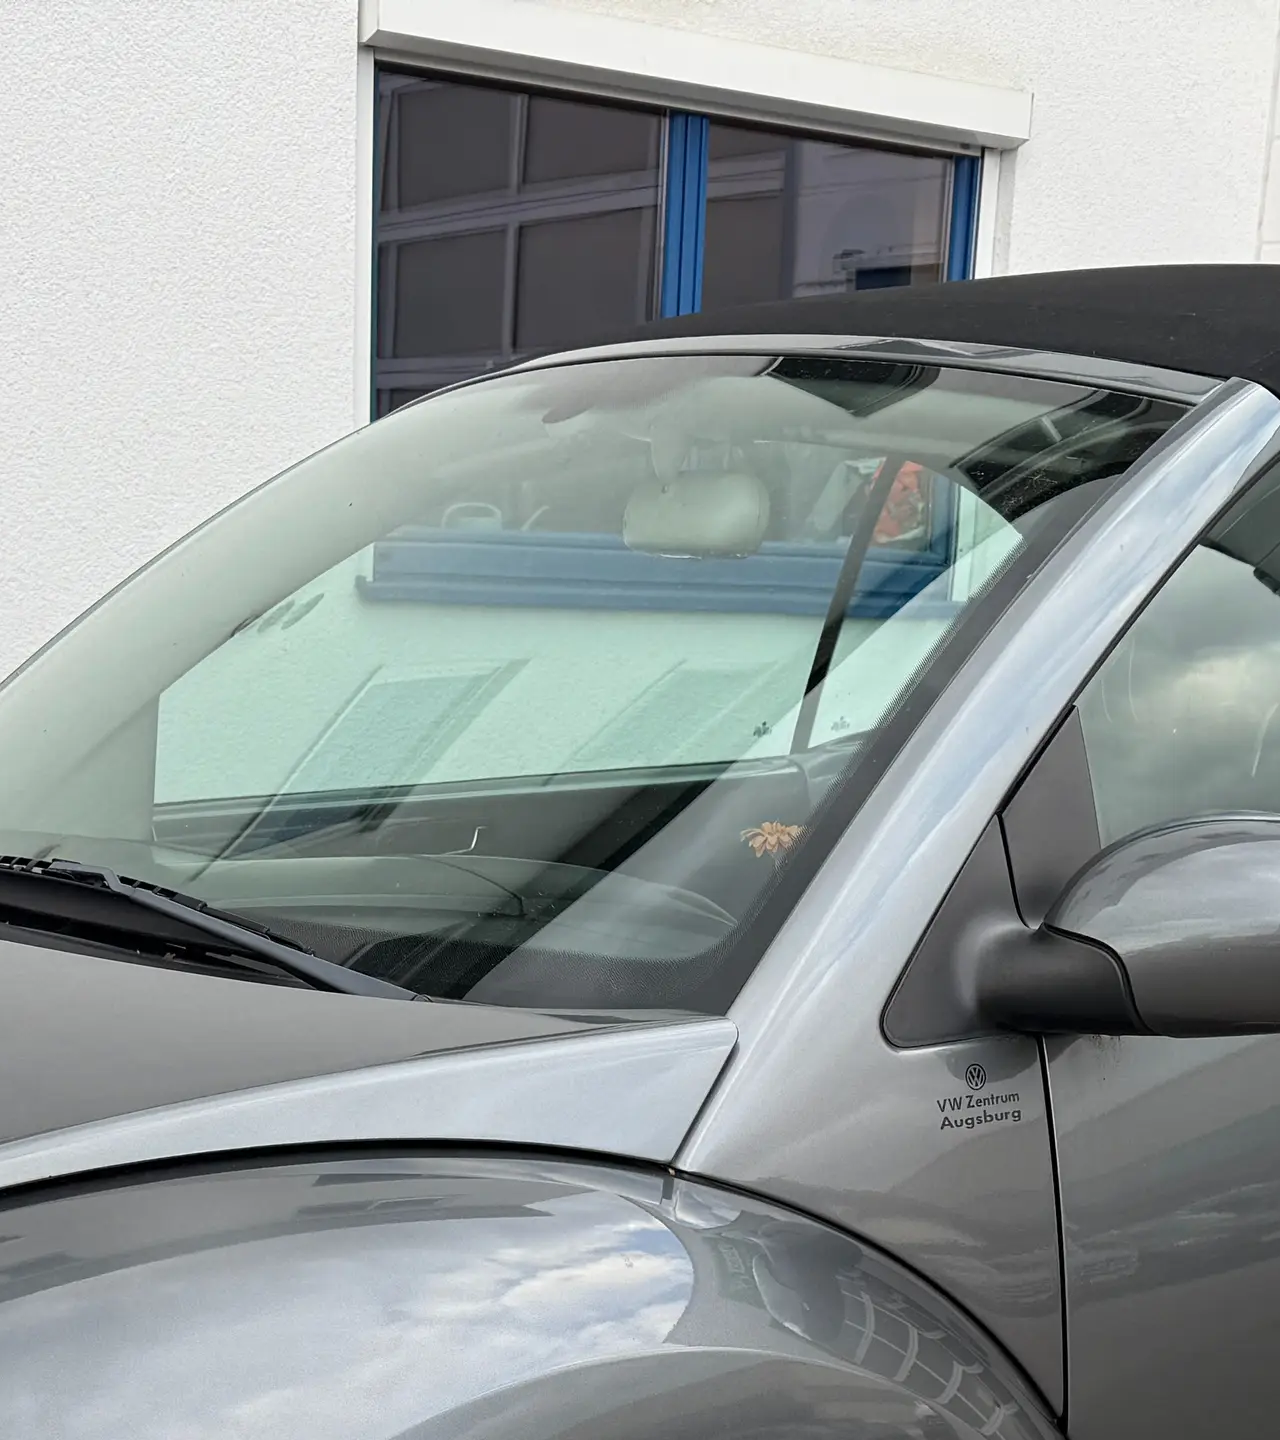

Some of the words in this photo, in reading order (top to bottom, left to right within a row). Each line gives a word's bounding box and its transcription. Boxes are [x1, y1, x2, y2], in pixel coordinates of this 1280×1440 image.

[937, 1097, 962, 1112] VW
[965, 1092, 1020, 1109] Zentrum
[940, 1109, 1022, 1130] Augsburg
